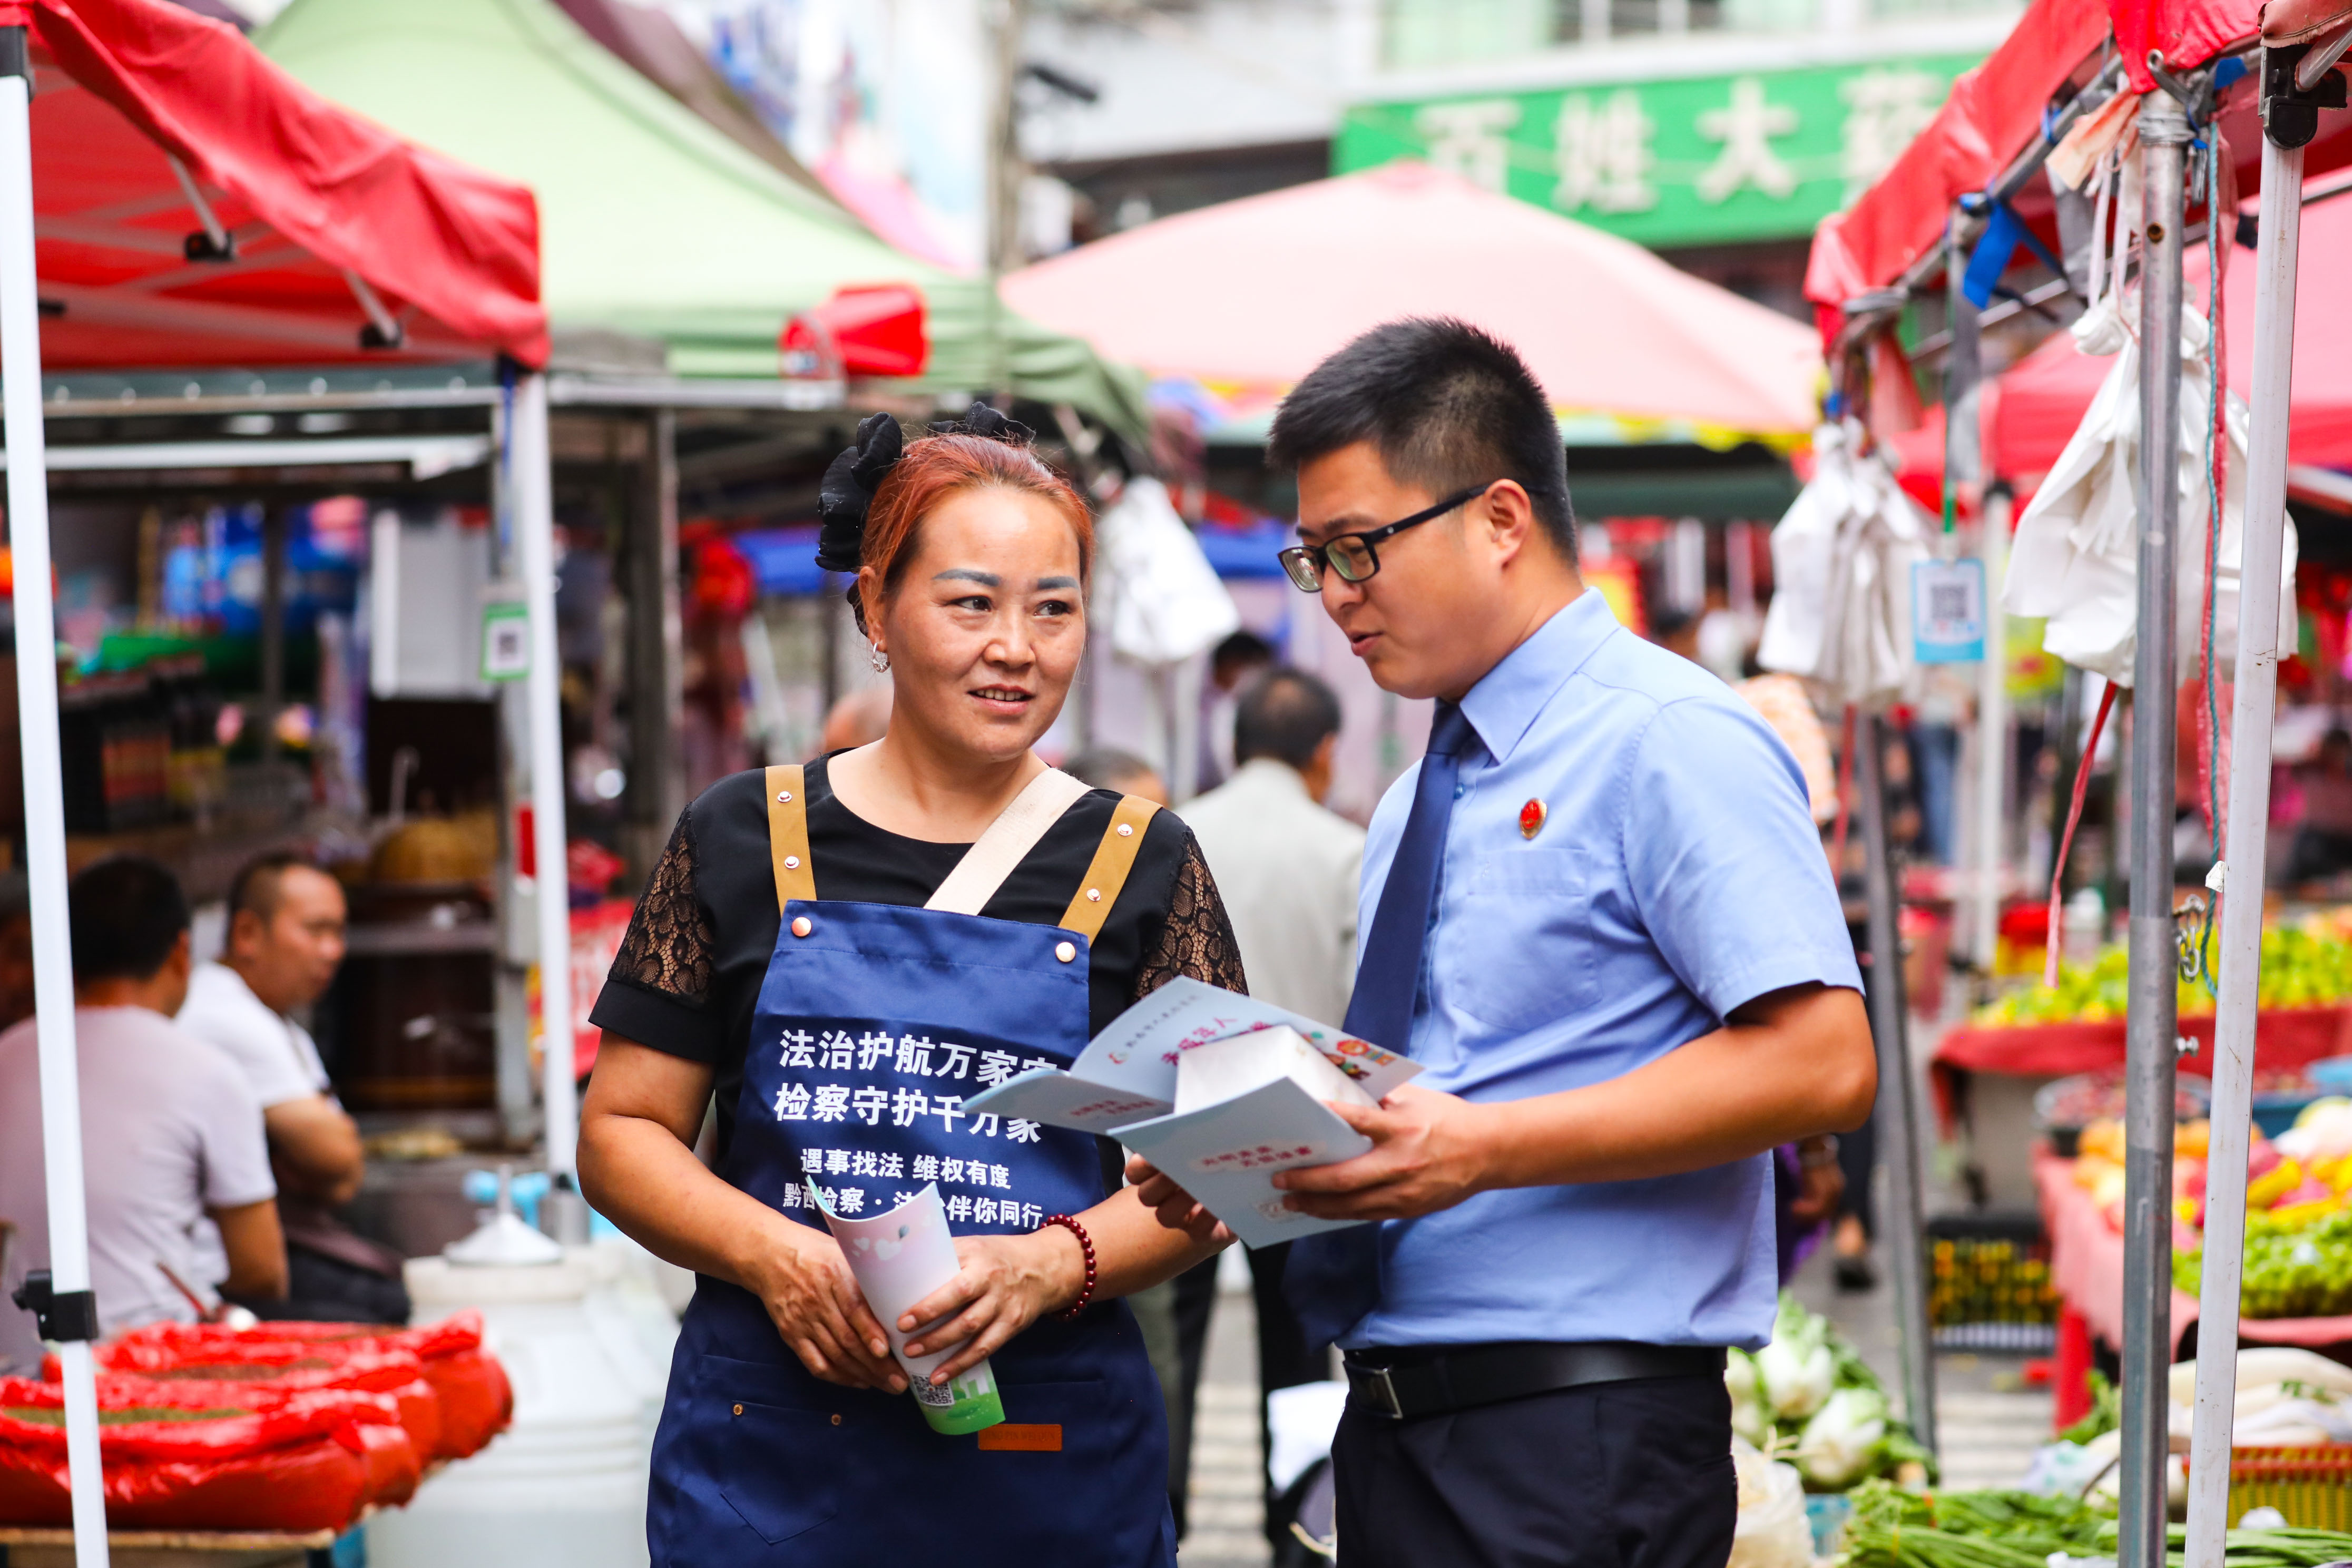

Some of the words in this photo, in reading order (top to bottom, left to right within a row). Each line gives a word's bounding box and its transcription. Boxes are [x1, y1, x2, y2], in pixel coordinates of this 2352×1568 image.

[801, 1148, 904, 1179] 遇事找法
[913, 1154, 1012, 1190] 维权有度
